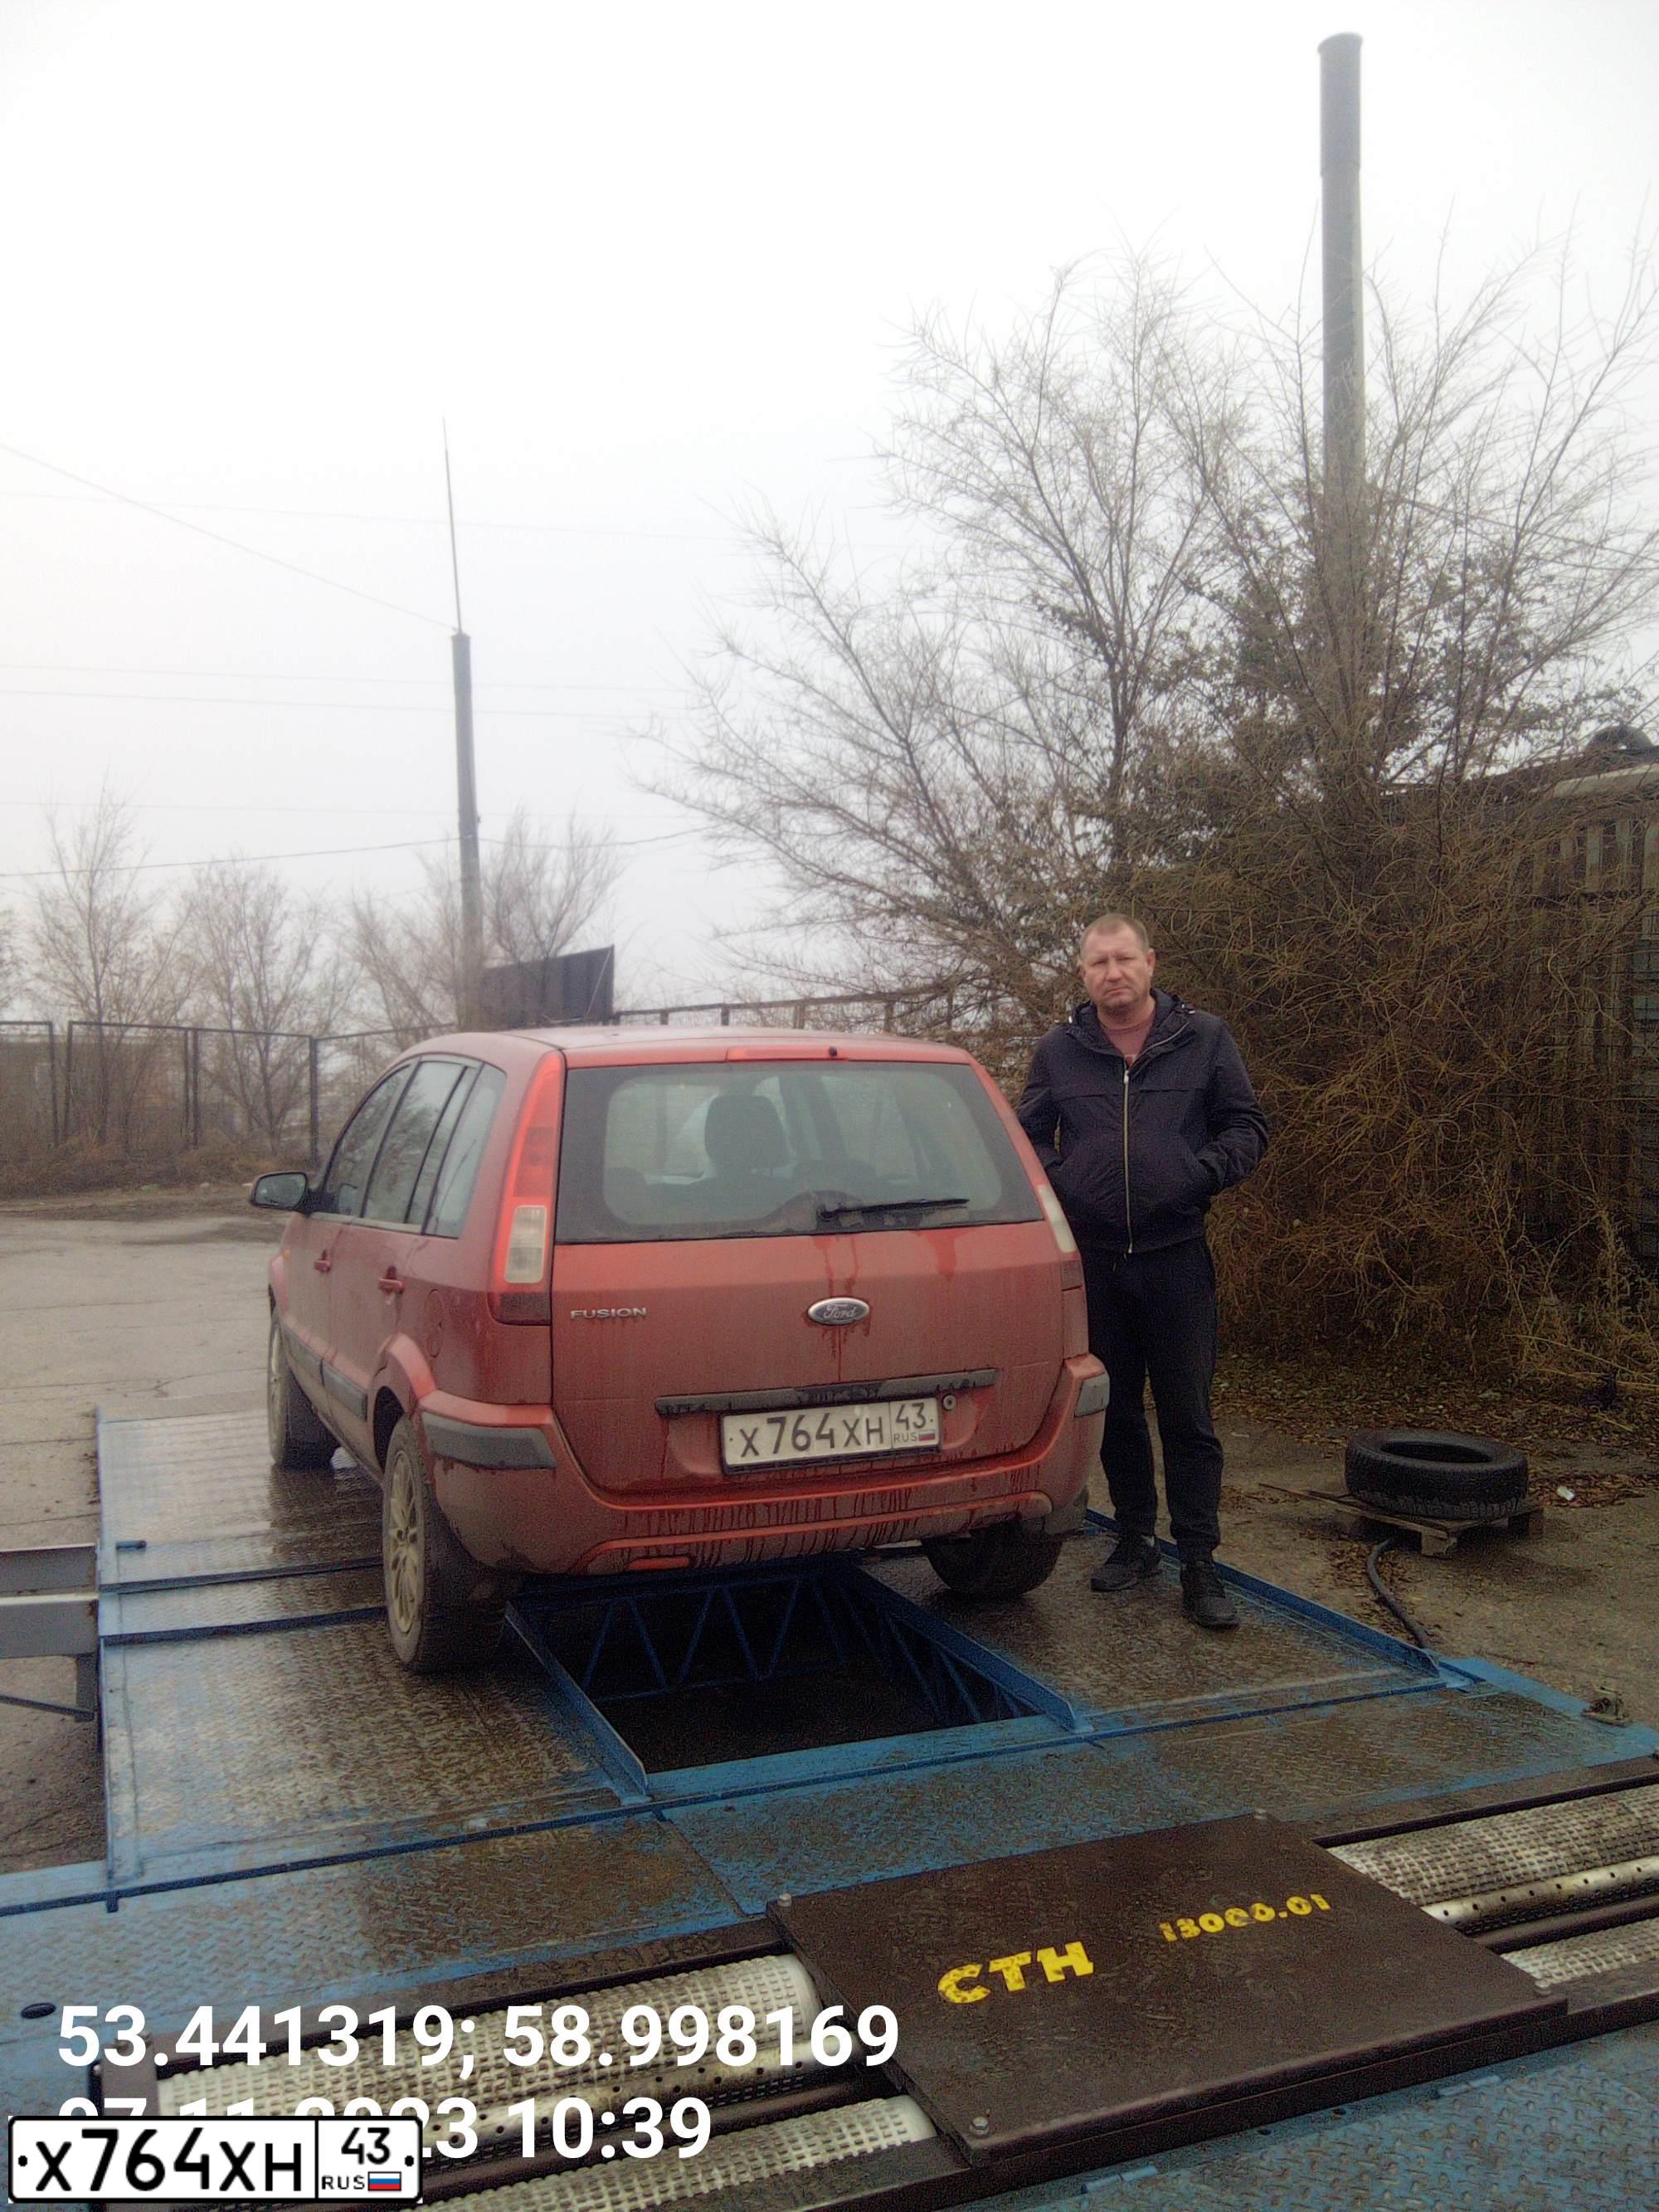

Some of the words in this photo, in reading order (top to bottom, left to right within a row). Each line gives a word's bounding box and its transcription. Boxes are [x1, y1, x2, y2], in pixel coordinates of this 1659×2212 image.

[570, 1307, 648, 1320] FUSION
[739, 1412, 884, 1458] Х764ХН
[895, 1402, 927, 1431] 43
[893, 1433, 917, 1444] RUS
